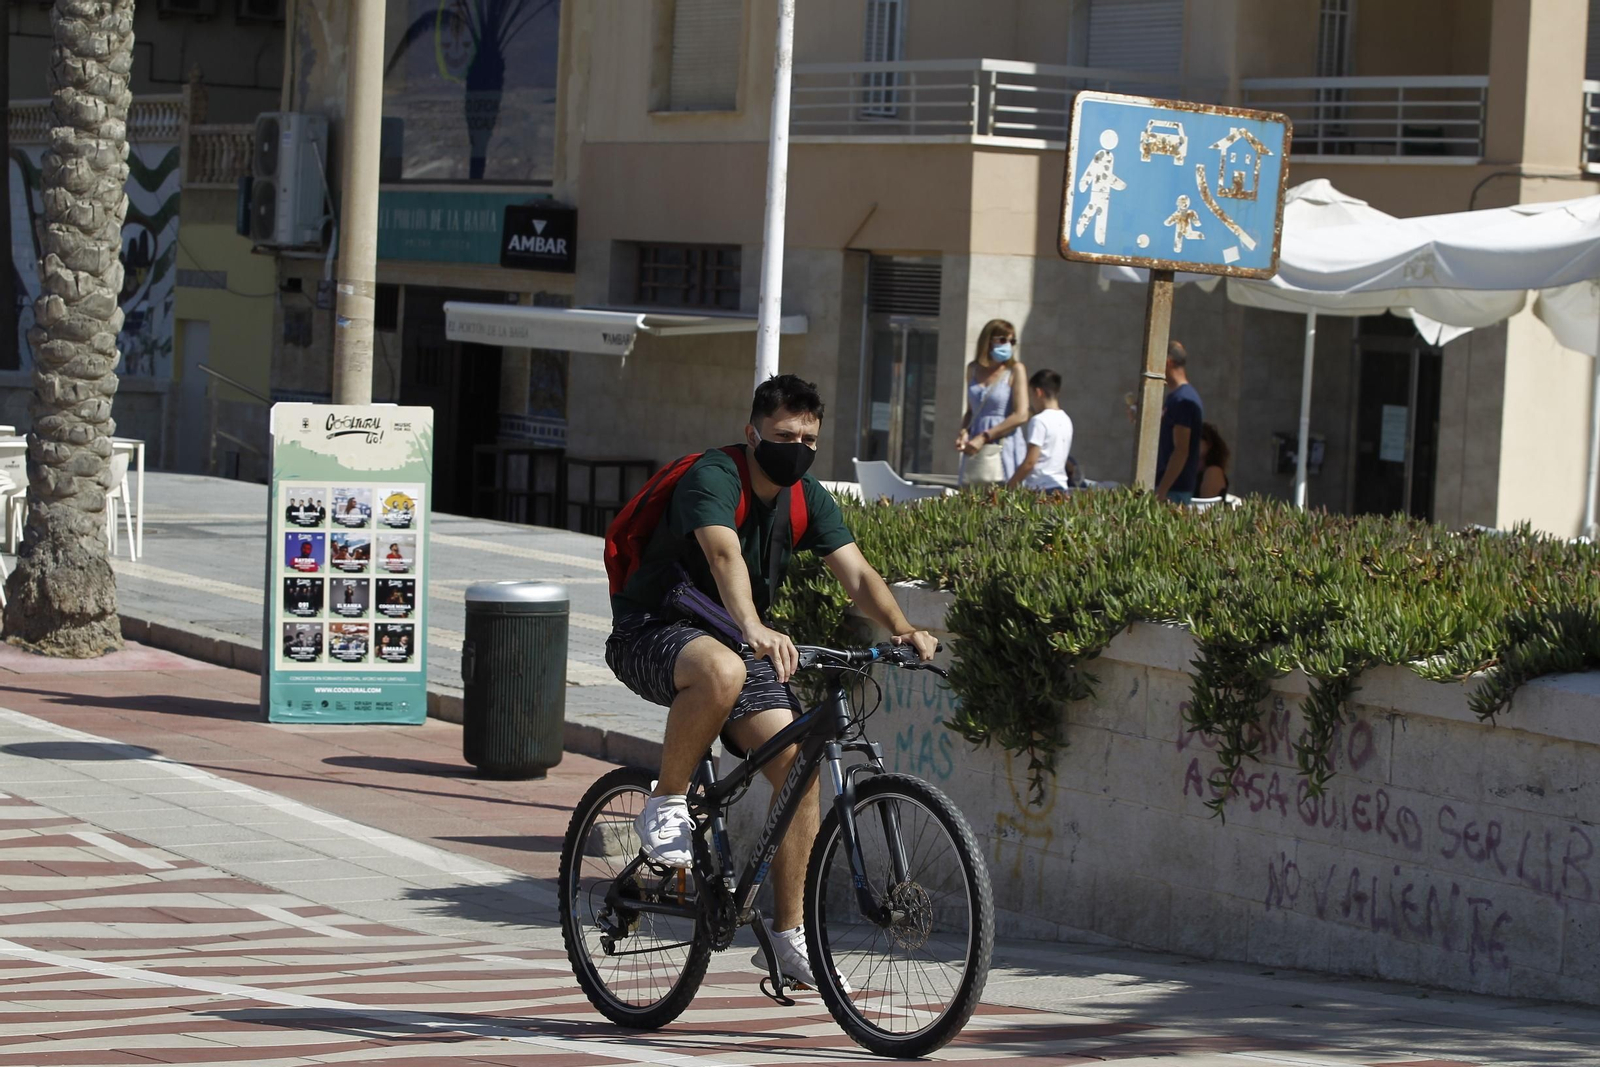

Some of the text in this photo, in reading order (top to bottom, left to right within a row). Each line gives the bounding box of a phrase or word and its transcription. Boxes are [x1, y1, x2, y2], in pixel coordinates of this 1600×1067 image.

[508, 234, 567, 255] AMBAR
[895, 715, 954, 778] MÁS
[750, 751, 807, 869] ROCKRIDER
[1183, 757, 1203, 797] A
[1297, 778, 1422, 852] QUIERO
[1438, 804, 1507, 876] SER
[1265, 851, 1514, 976] NO VALIENTE
